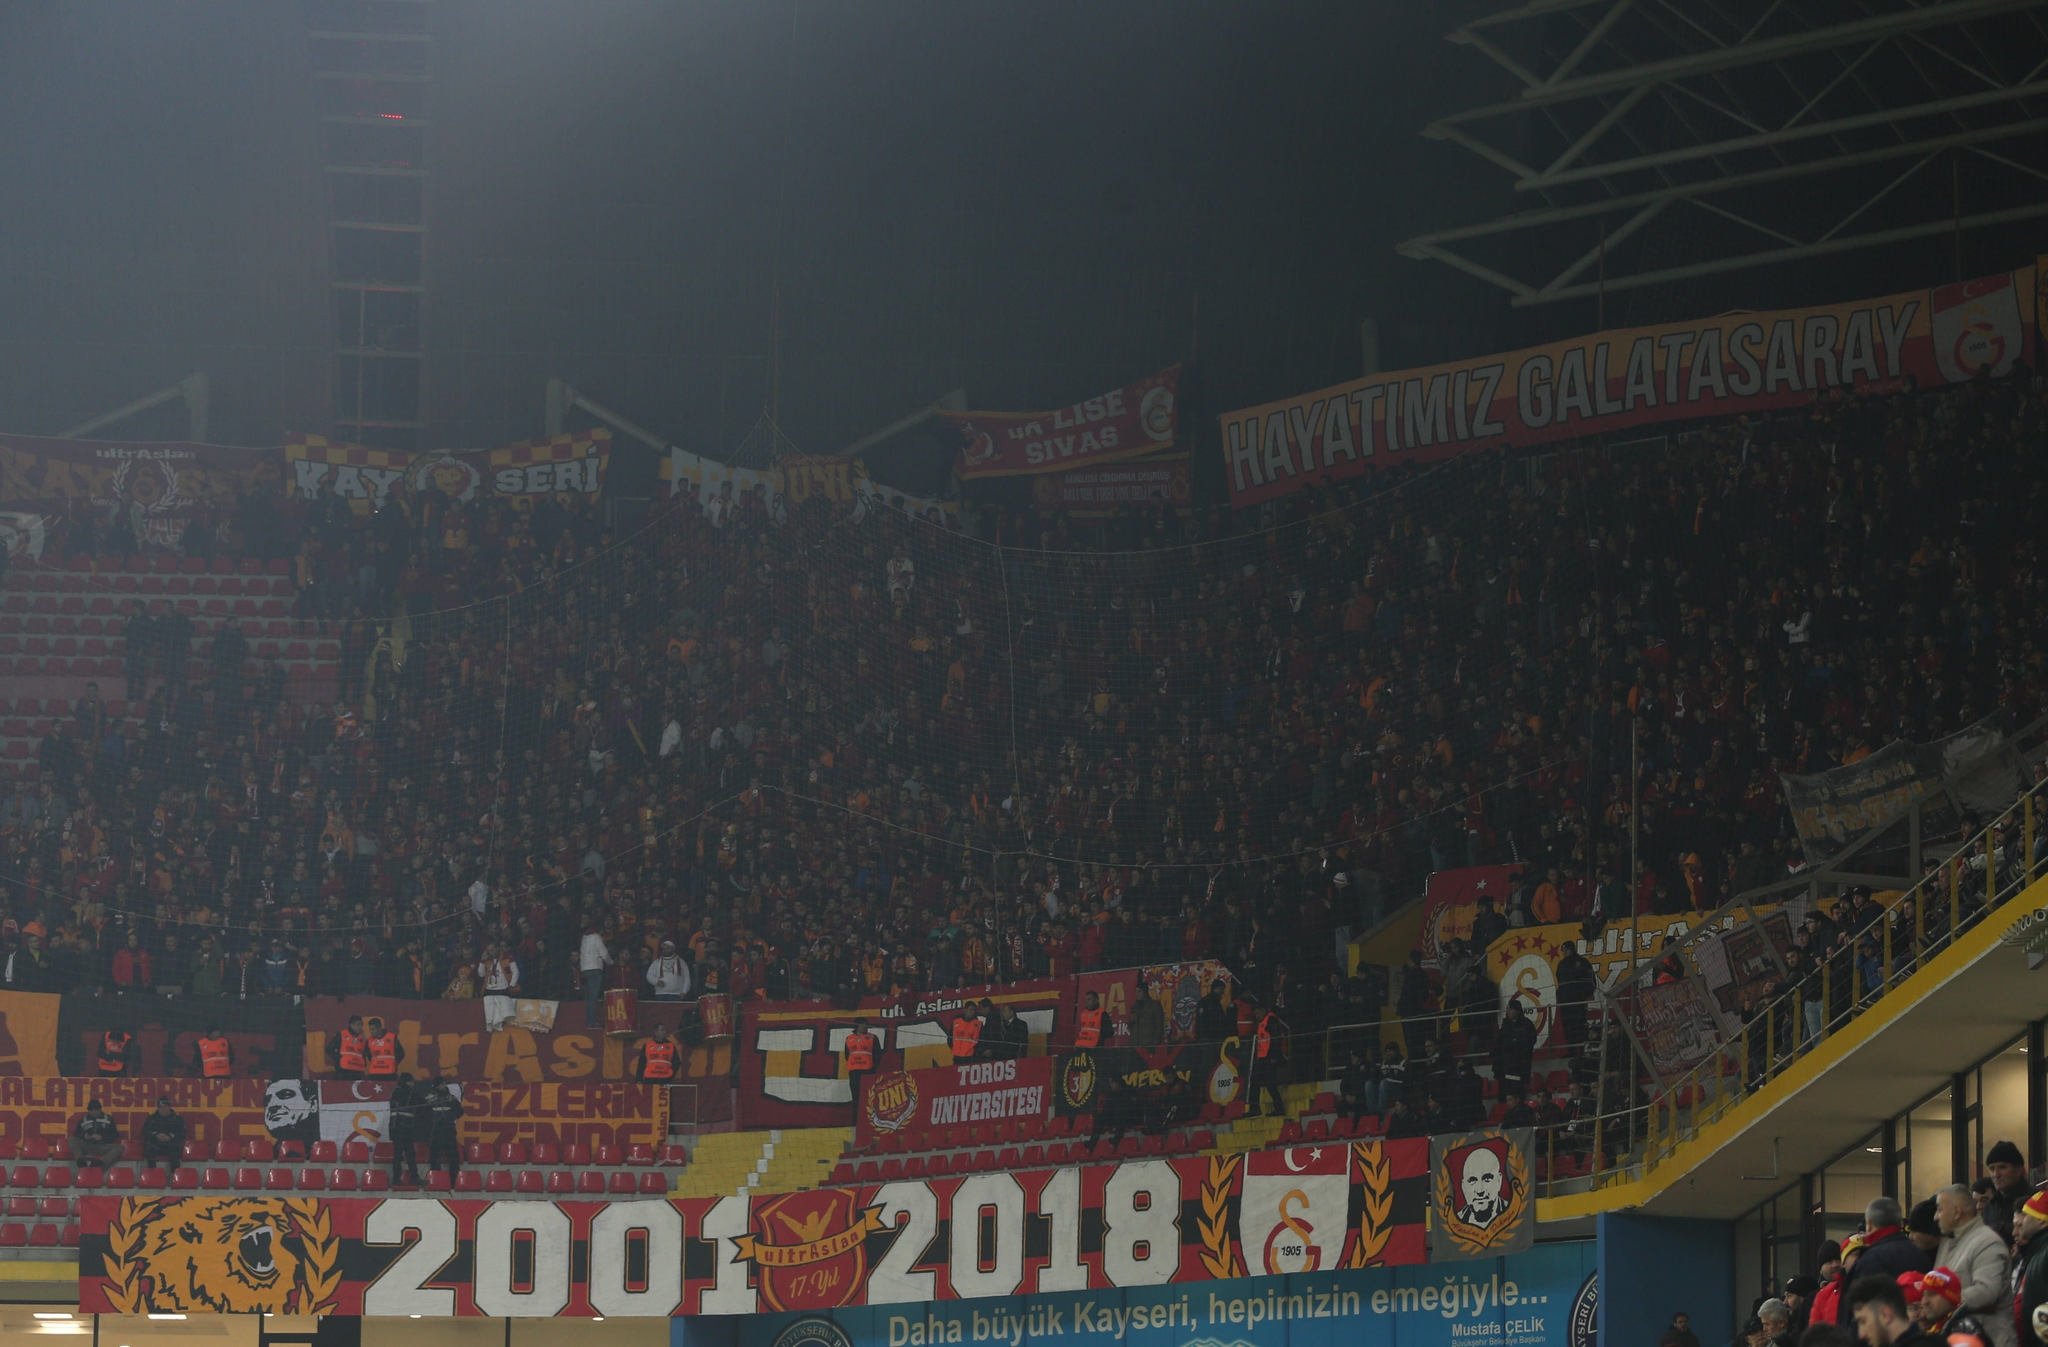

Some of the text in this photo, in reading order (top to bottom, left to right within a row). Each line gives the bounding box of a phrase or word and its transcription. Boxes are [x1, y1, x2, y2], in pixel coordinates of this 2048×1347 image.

[1228, 300, 1921, 493] HAYATIMIZ GALATASARAY
[1024, 427, 1120, 465] SIVAS
[957, 1058, 1017, 1088] TOROS
[764, 1231, 860, 1264] ultrAslan
[867, 1158, 1183, 1303] 2018
[363, 1196, 758, 1318] 2001
[1280, 1245, 1302, 1257] 1905
[888, 1273, 1549, 1347] Daha büyük Kayseri, hepimizin emeğiyle...
[1451, 1316, 1545, 1338] Mustafa ÇELİK
